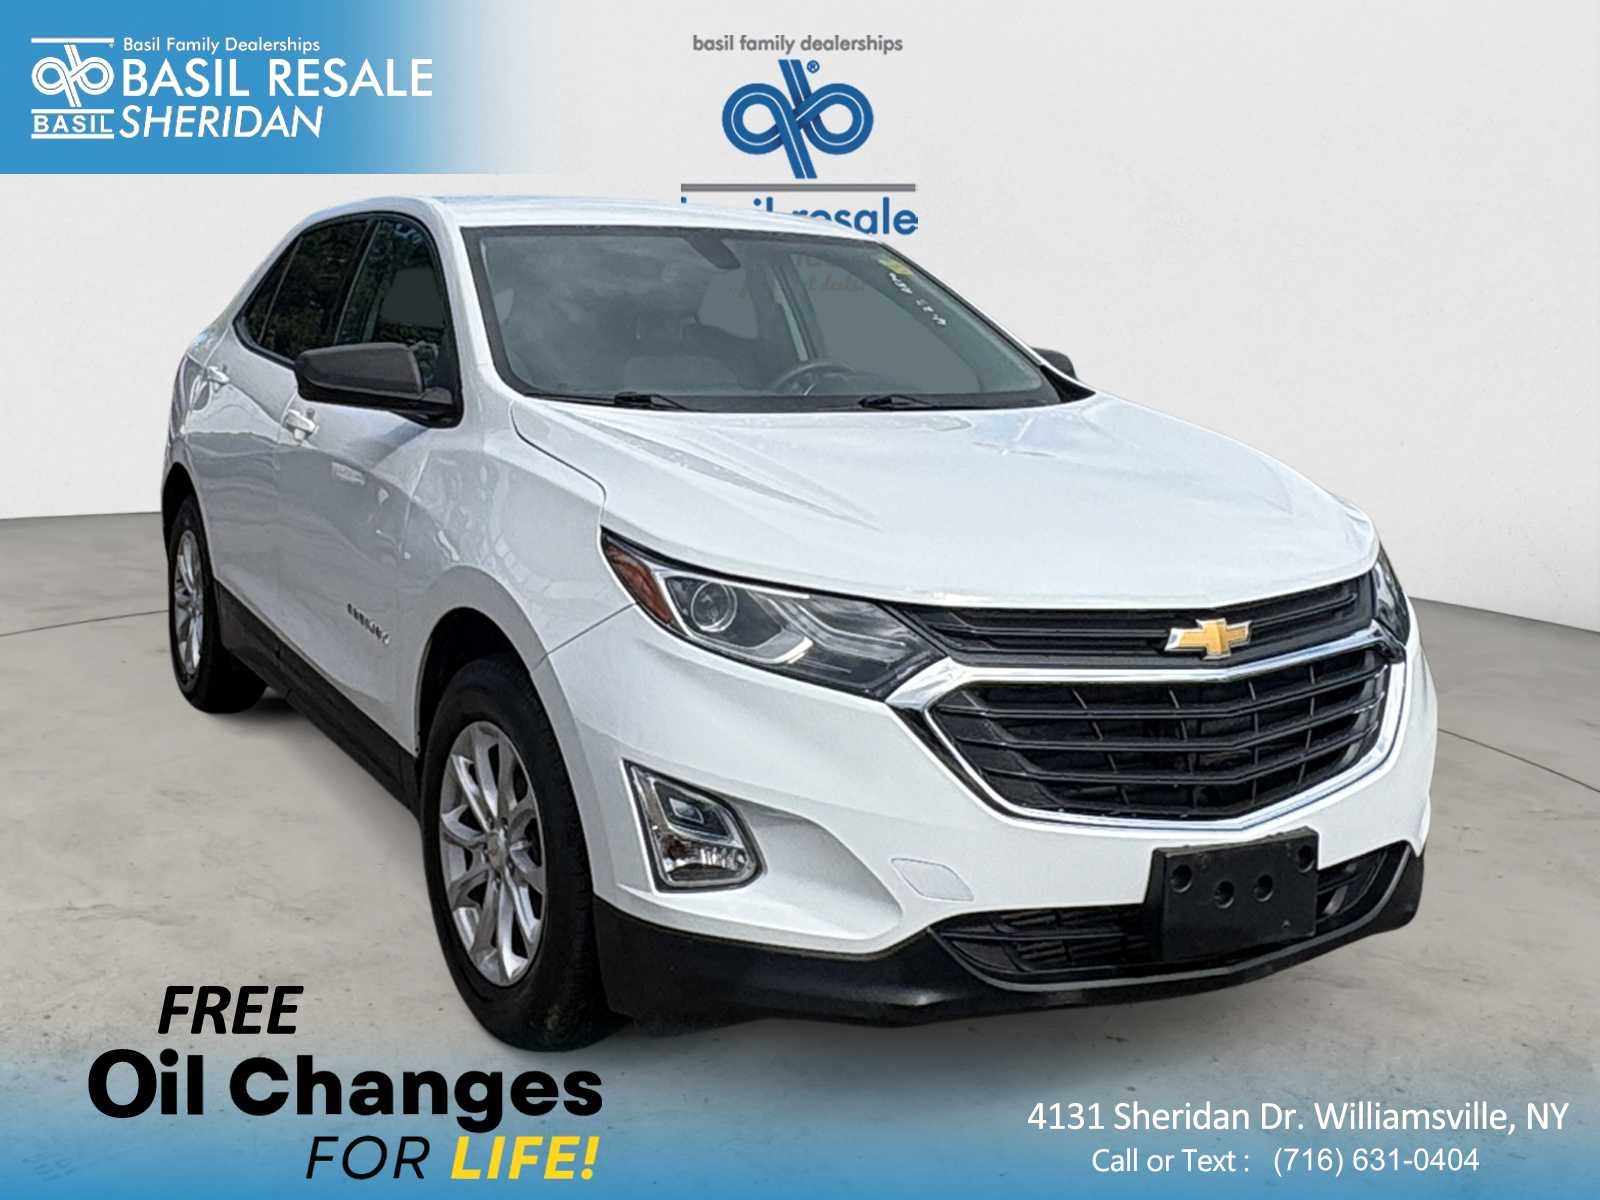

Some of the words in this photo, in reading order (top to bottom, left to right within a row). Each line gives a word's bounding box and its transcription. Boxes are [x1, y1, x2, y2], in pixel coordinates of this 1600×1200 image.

[692, 34, 734, 51] basil
[739, 34, 796, 55] family
[800, 34, 904, 55] dealerships
[791, 196, 919, 235] sale
